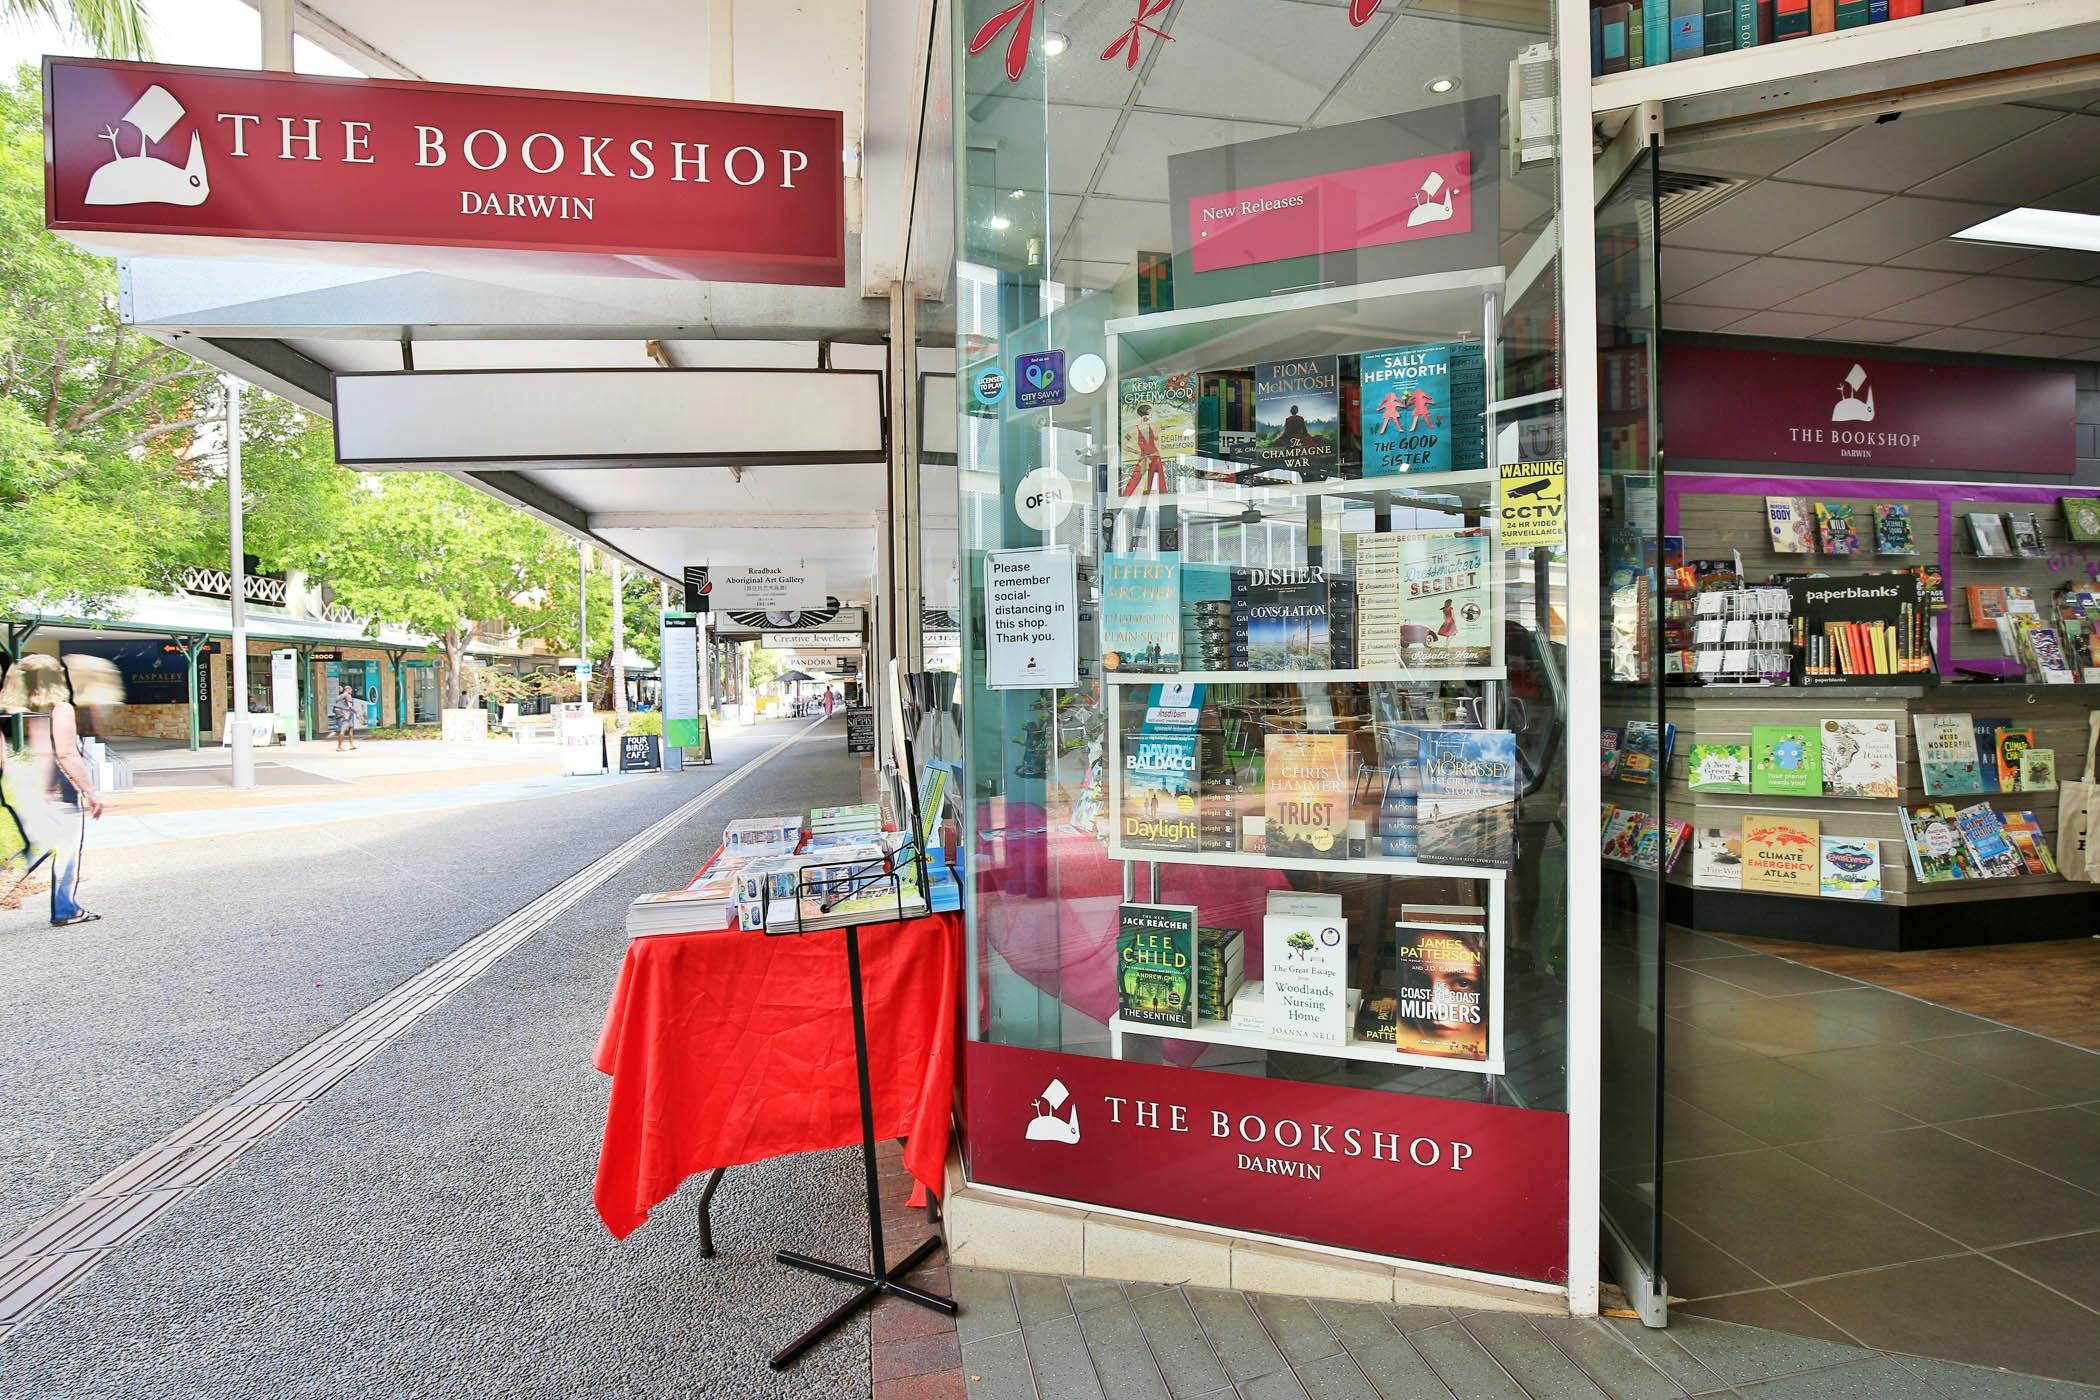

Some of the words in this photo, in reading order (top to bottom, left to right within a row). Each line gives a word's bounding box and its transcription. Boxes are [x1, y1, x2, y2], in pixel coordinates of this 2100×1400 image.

[217, 112, 375, 166] THE
[414, 125, 809, 190] BOOKSHOP
[460, 191, 596, 222] DARWIN
[1203, 207, 1236, 221] New
[1240, 195, 1304, 215] Releases
[1384, 353, 1427, 368] SALLY
[1273, 361, 1318, 378] FIONA
[1365, 363, 1447, 383] HEPWORTH
[978, 376, 1004, 385] LICENSED
[988, 382, 1002, 390] PLAY
[1132, 381, 1158, 391] KERRY
[1258, 374, 1335, 395] McINTOSH
[1021, 393, 1037, 401] CITY
[1037, 390, 1060, 400] SAVVY
[1125, 387, 1193, 404] GREENWOOD
[1289, 437, 1303, 447] The
[1375, 441, 1398, 452] THE
[1399, 434, 1439, 450] GOOD
[1790, 427, 1824, 443] THE
[1831, 430, 1921, 448] BOOKSHOP
[1262, 445, 1332, 459] CHAMPAGNE
[1381, 450, 1431, 467] SISTER
[1841, 449, 1872, 458] DARWIN
[1284, 458, 1311, 468] WAR
[1501, 461, 1563, 478] WARNING
[1026, 489, 1063, 509] OPEN
[1502, 504, 1563, 519] CCTV
[1770, 509, 1792, 520] BODY
[1532, 519, 1557, 528] VIDEO
[1829, 519, 1846, 530] WILD
[1501, 529, 1563, 537] SURVEILLANCE
[1432, 553, 1449, 564] THE
[993, 563, 1031, 573] Please
[1107, 564, 1175, 579] JEFFREY
[726, 577, 763, 585] Aboriginal
[778, 576, 805, 585] Gallery
[994, 576, 1051, 587] remember
[1250, 565, 1325, 587] DISHER
[1410, 572, 1476, 596] SECRET
[994, 590, 1031, 601] social-
[1108, 585, 1176, 599] ARCHER
[1806, 586, 1898, 604] paperblanks
[995, 604, 1052, 615] distancing
[1055, 602, 1065, 612] in
[1250, 605, 1326, 618] CONSOLATION
[996, 619, 1016, 629] this
[1018, 618, 1048, 629] shop.
[773, 634, 811, 643] Creative
[812, 634, 850, 643] Jewellers
[996, 633, 1030, 643] Thank
[1032, 633, 1055, 644] you.
[1104, 632, 1138, 641] PLAIN
[1141, 631, 1176, 641] SIGHT
[1412, 650, 1450, 660] Rosalie
[1454, 650, 1479, 659] Ham
[132, 672, 183, 681] PASPALEY
[1140, 744, 1183, 755] DAVID
[1126, 755, 1196, 771] BALDACCI
[1443, 752, 1457, 762] Di
[1426, 758, 1510, 779] MORRISSEY
[1713, 761, 1731, 769] New
[1281, 767, 1329, 779] CHRIS
[1785, 773, 1808, 781] planet
[1271, 779, 1342, 792] HAMMER
[1431, 776, 1470, 786] BEFORE
[1445, 787, 1482, 797] STORM
[1277, 802, 1334, 826] TRUST
[1126, 818, 1197, 843] Daylight
[1758, 852, 1803, 862] CLIMATE
[1706, 866, 1722, 874] Fire
[1748, 859, 1814, 872] EMERGENCY
[1764, 869, 1797, 879] ATLAS
[1123, 917, 1144, 926] JACK
[1147, 919, 1188, 930] REACHER
[1137, 934, 1172, 949] LEE
[1417, 938, 1463, 949] JAMES
[1123, 947, 1187, 968] CHILD
[1400, 947, 1481, 962] PATTERSON
[1272, 964, 1288, 973] The
[1288, 965, 1309, 974] Great
[1311, 968, 1337, 978] Escape
[1275, 981, 1334, 997] Woodlands
[1401, 986, 1481, 1005] COAST-TO-COAST
[1283, 995, 1326, 1012] Nursing
[1123, 1008, 1141, 1018] THE
[1143, 1010, 1187, 1024] SENTINEL
[1289, 1009, 1320, 1023] Home
[1401, 999, 1481, 1024] MURDERS
[1272, 1026, 1309, 1038] JOANNA
[1312, 1032, 1336, 1041] NELL
[1378, 1024, 1397, 1033] JAM
[1366, 1031, 1397, 1041] PATTE
[1104, 1095, 1190, 1134] THE
[1210, 1109, 1475, 1173] BOOKSHOP
[1236, 1153, 1323, 1183] DARWIN
